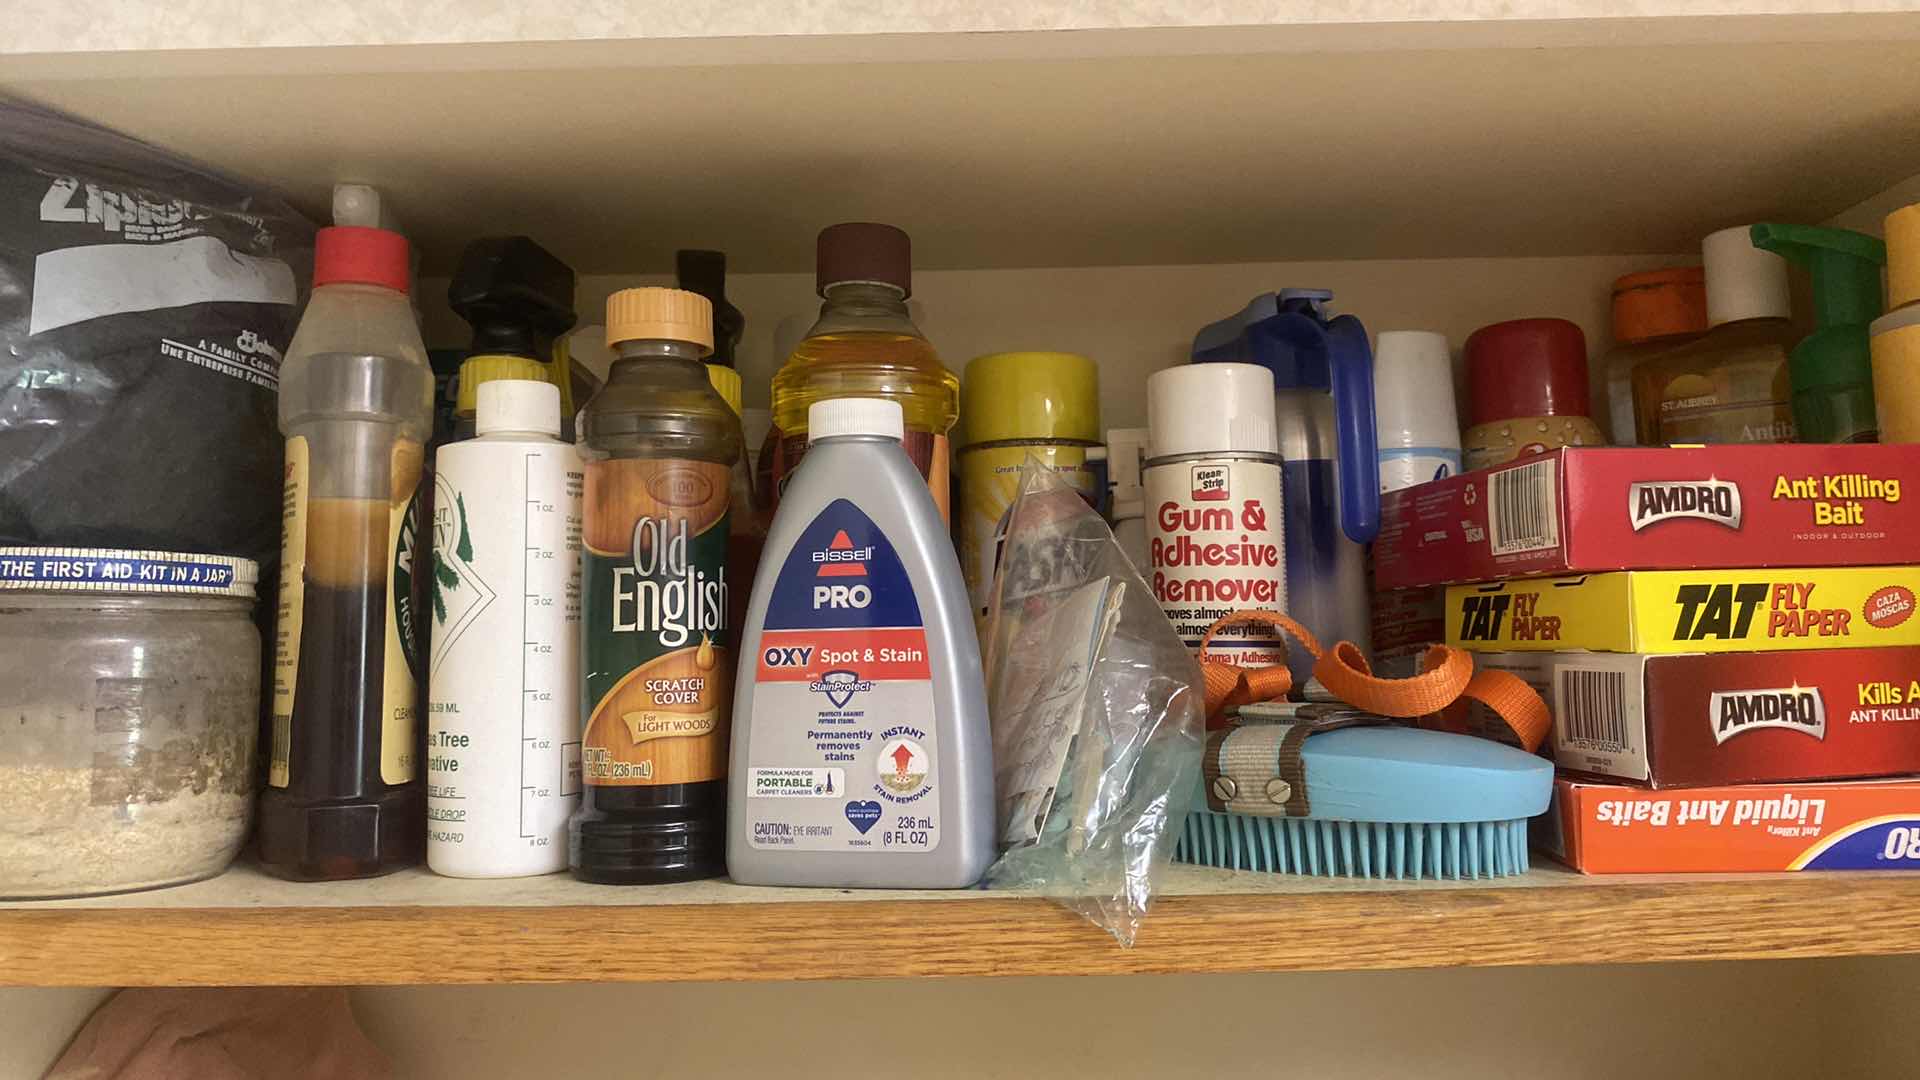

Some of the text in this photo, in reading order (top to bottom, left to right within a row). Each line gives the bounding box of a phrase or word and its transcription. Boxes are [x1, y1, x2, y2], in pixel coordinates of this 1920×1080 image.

[1197, 470, 1224, 481] Klean-
[1202, 478, 1224, 490] Strip
[1772, 474, 1901, 502] Ant Killing
[1636, 486, 1733, 521] AMDRO
[1814, 500, 1865, 525] Bait
[1157, 500, 1267, 532] Gum &
[1792, 532, 1829, 540] INDOOR
[633, 516, 688, 577] Old
[1151, 534, 1279, 568] Adhesive
[42, 561, 97, 578] FIRST
[101, 563, 134, 579] AID
[140, 564, 168, 581] KIT
[170, 566, 187, 582] IN
[190, 568, 200, 582] A
[1153, 571, 1279, 603] Remover
[1771, 583, 1816, 610] FLY
[612, 565, 728, 647] English
[813, 584, 873, 610] PRO
[1513, 592, 1540, 617] FLY
[1876, 592, 1901, 608] CAZA
[1459, 594, 1512, 641] TAT
[1673, 583, 1770, 641] TAT
[1871, 600, 1911, 620] MOSCAS
[1511, 615, 1561, 641] PAPER
[1767, 608, 1852, 638] PAPER
[764, 646, 923, 667] OXY Spot & Stain
[645, 678, 704, 692] SCRATCH
[1858, 682, 1903, 706] Kills
[654, 691, 698, 704] COVER
[643, 713, 657, 722] For
[1719, 692, 1820, 732] AMDRO
[1849, 708, 1920, 723] ANT KILLIN
[638, 719, 711, 732] LIGHT WOODS
[880, 726, 926, 741] INSTANT
[438, 730, 470, 748] Tree
[807, 731, 873, 741] Permanently
[816, 742, 861, 751] removes
[824, 752, 855, 761] stains
[757, 779, 813, 787] PORTABLE
[530, 790, 536, 798] 7
[873, 784, 933, 804] STAIN REMOVAL
[440, 809, 466, 820] DROP
[1596, 793, 1826, 826] Liquid Ant Baits
[754, 822, 832, 836] CAUTION: EYE IRRITANT
[898, 816, 934, 829] 236 mL
[1800, 826, 1821, 837] Ant
[432, 831, 465, 843] HAZARD
[883, 831, 928, 847] (8 FL OZ)
